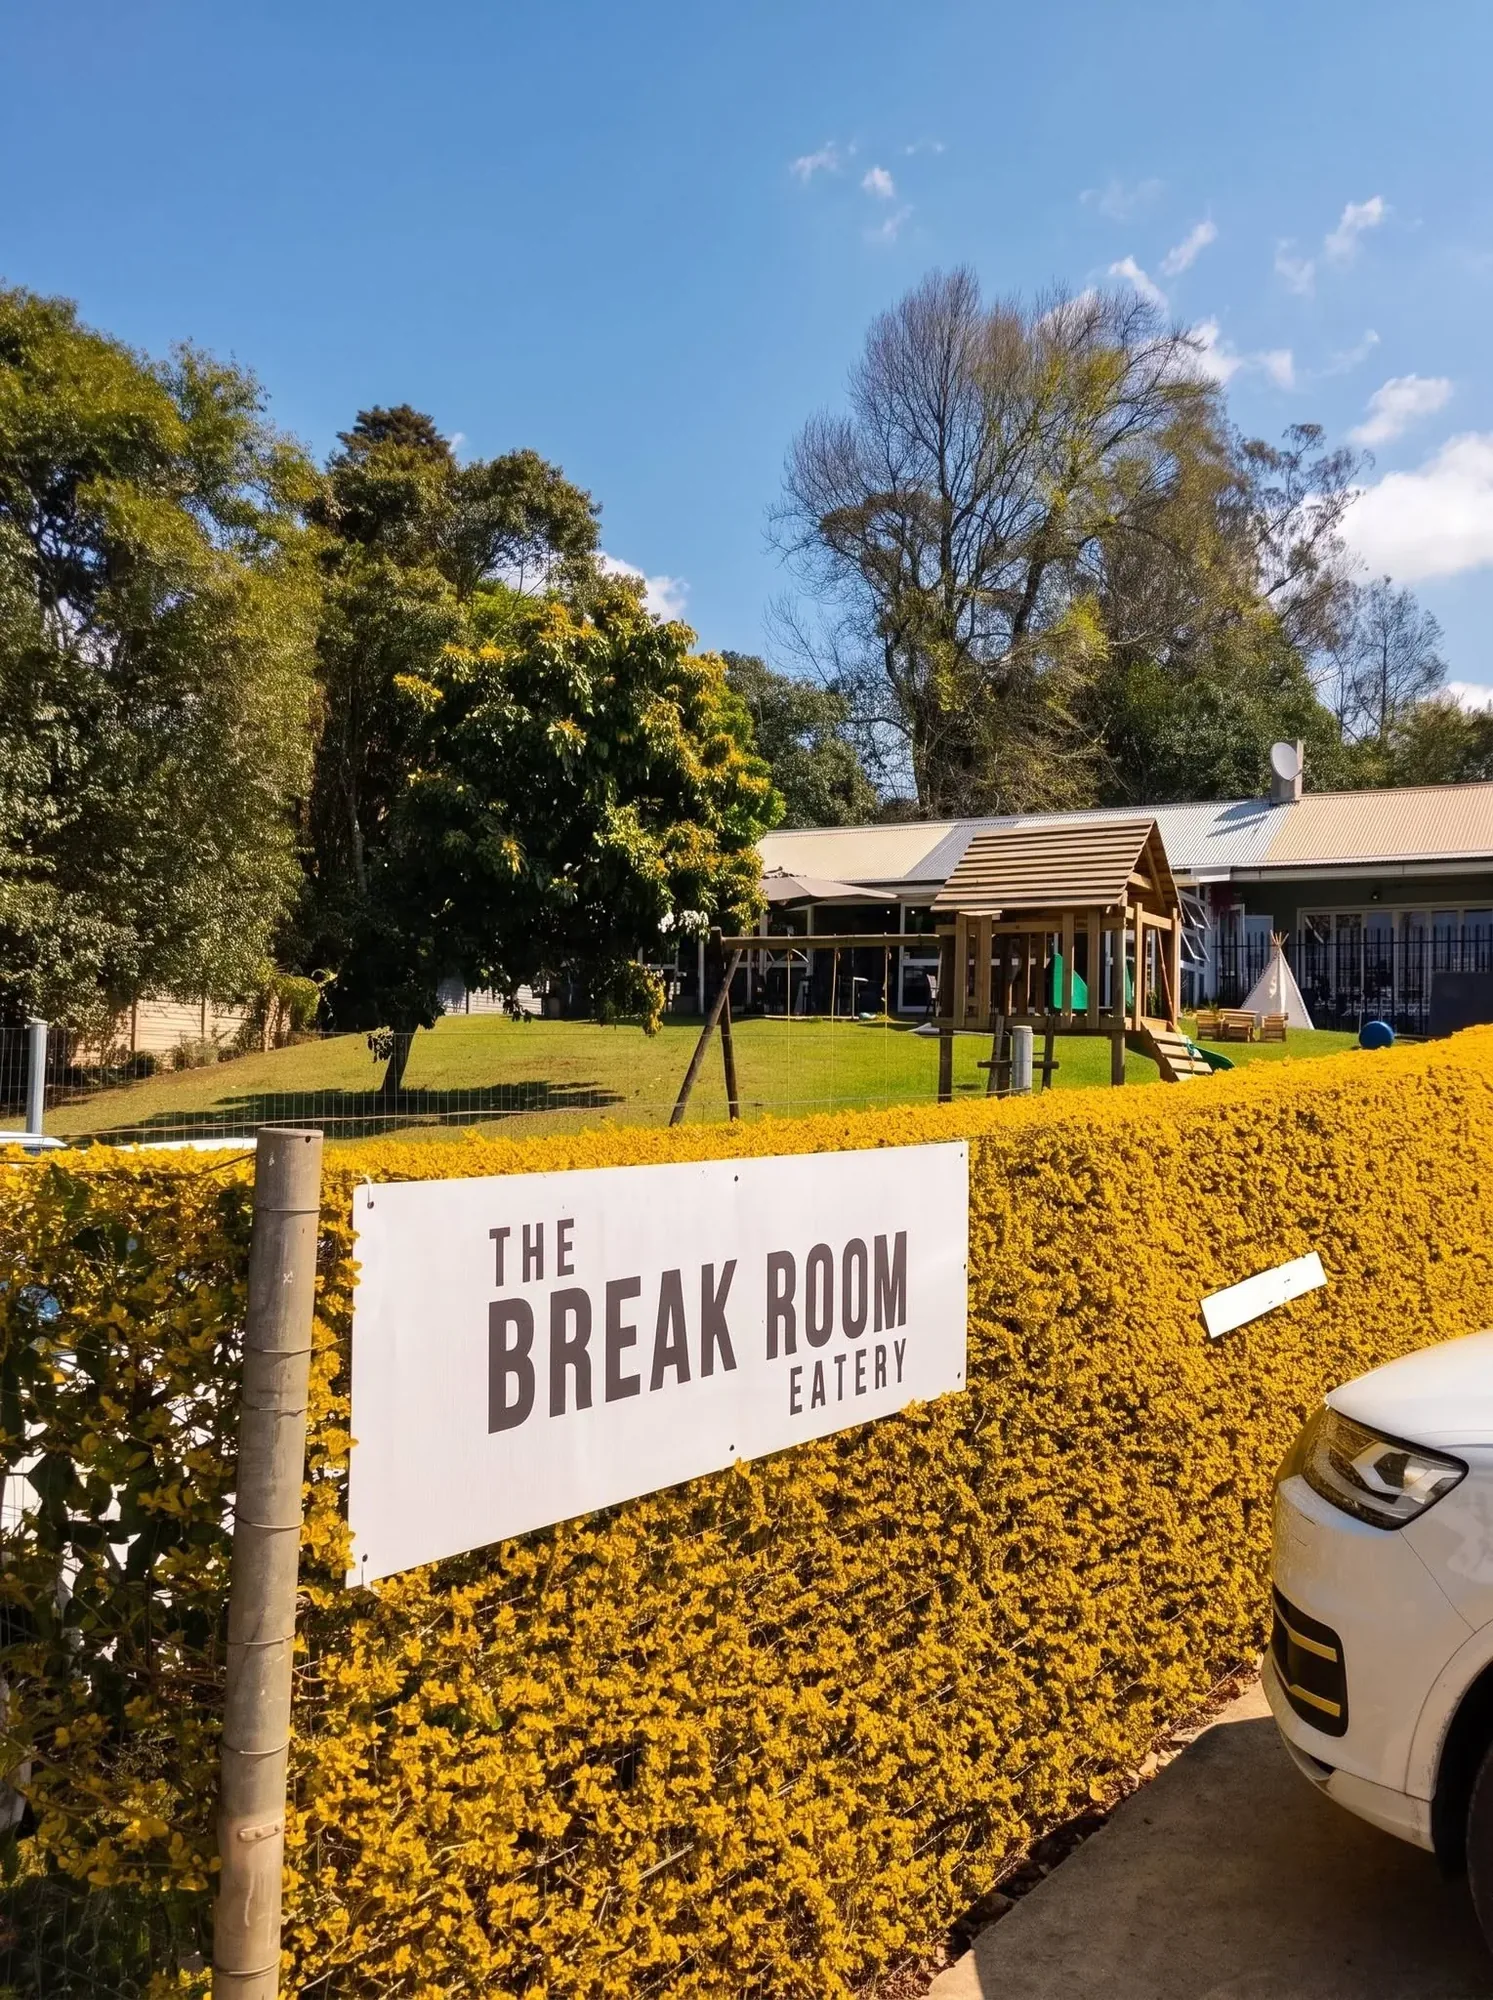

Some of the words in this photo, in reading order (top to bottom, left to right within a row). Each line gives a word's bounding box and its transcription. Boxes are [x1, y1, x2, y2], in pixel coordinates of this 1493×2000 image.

[488, 1218, 575, 1287] THE
[488, 1259, 738, 1434] BREAK
[767, 1231, 907, 1361] ROOM
[789, 1338, 907, 1416] EATERY
